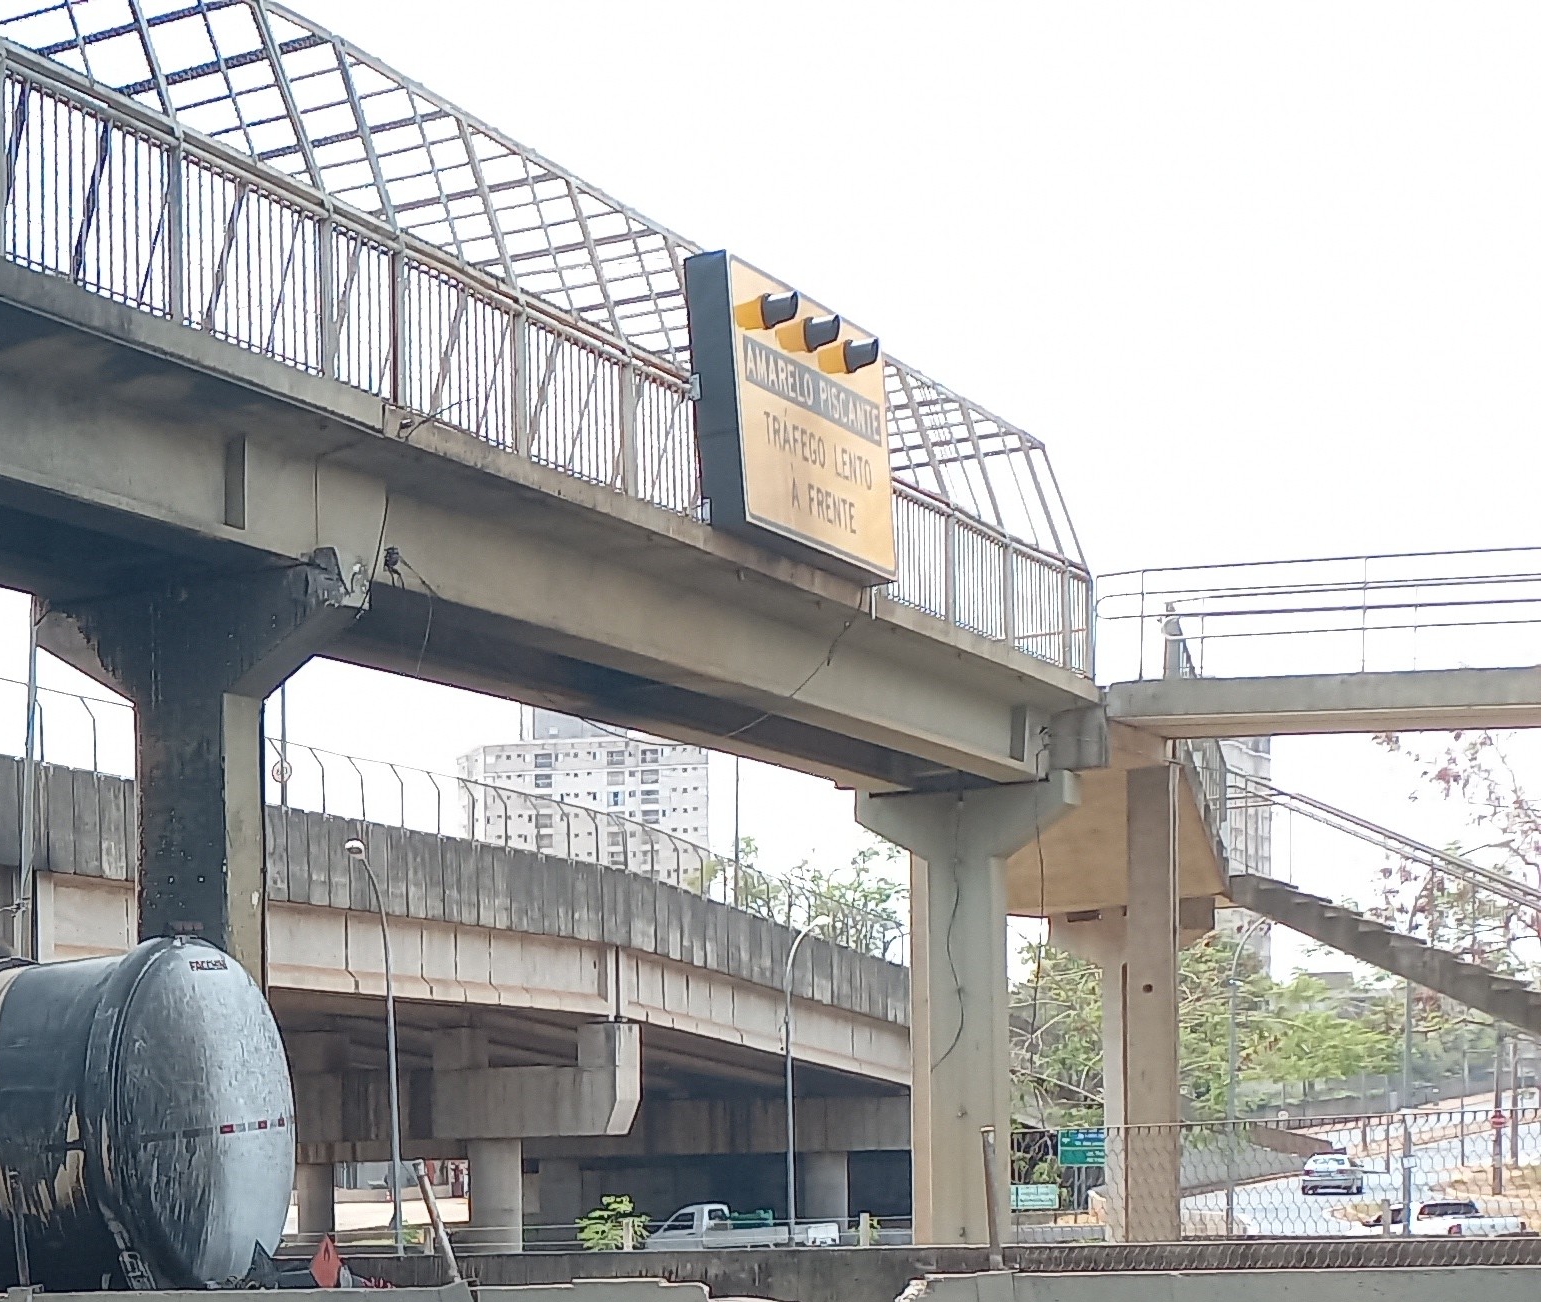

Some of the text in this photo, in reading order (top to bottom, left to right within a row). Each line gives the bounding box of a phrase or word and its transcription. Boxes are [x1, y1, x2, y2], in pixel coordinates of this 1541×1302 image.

[746, 343, 881, 440] AMARELO PISCANTE
[764, 408, 873, 490] TRÁFEGO LENTO
[791, 463, 857, 534] À FRENTE
